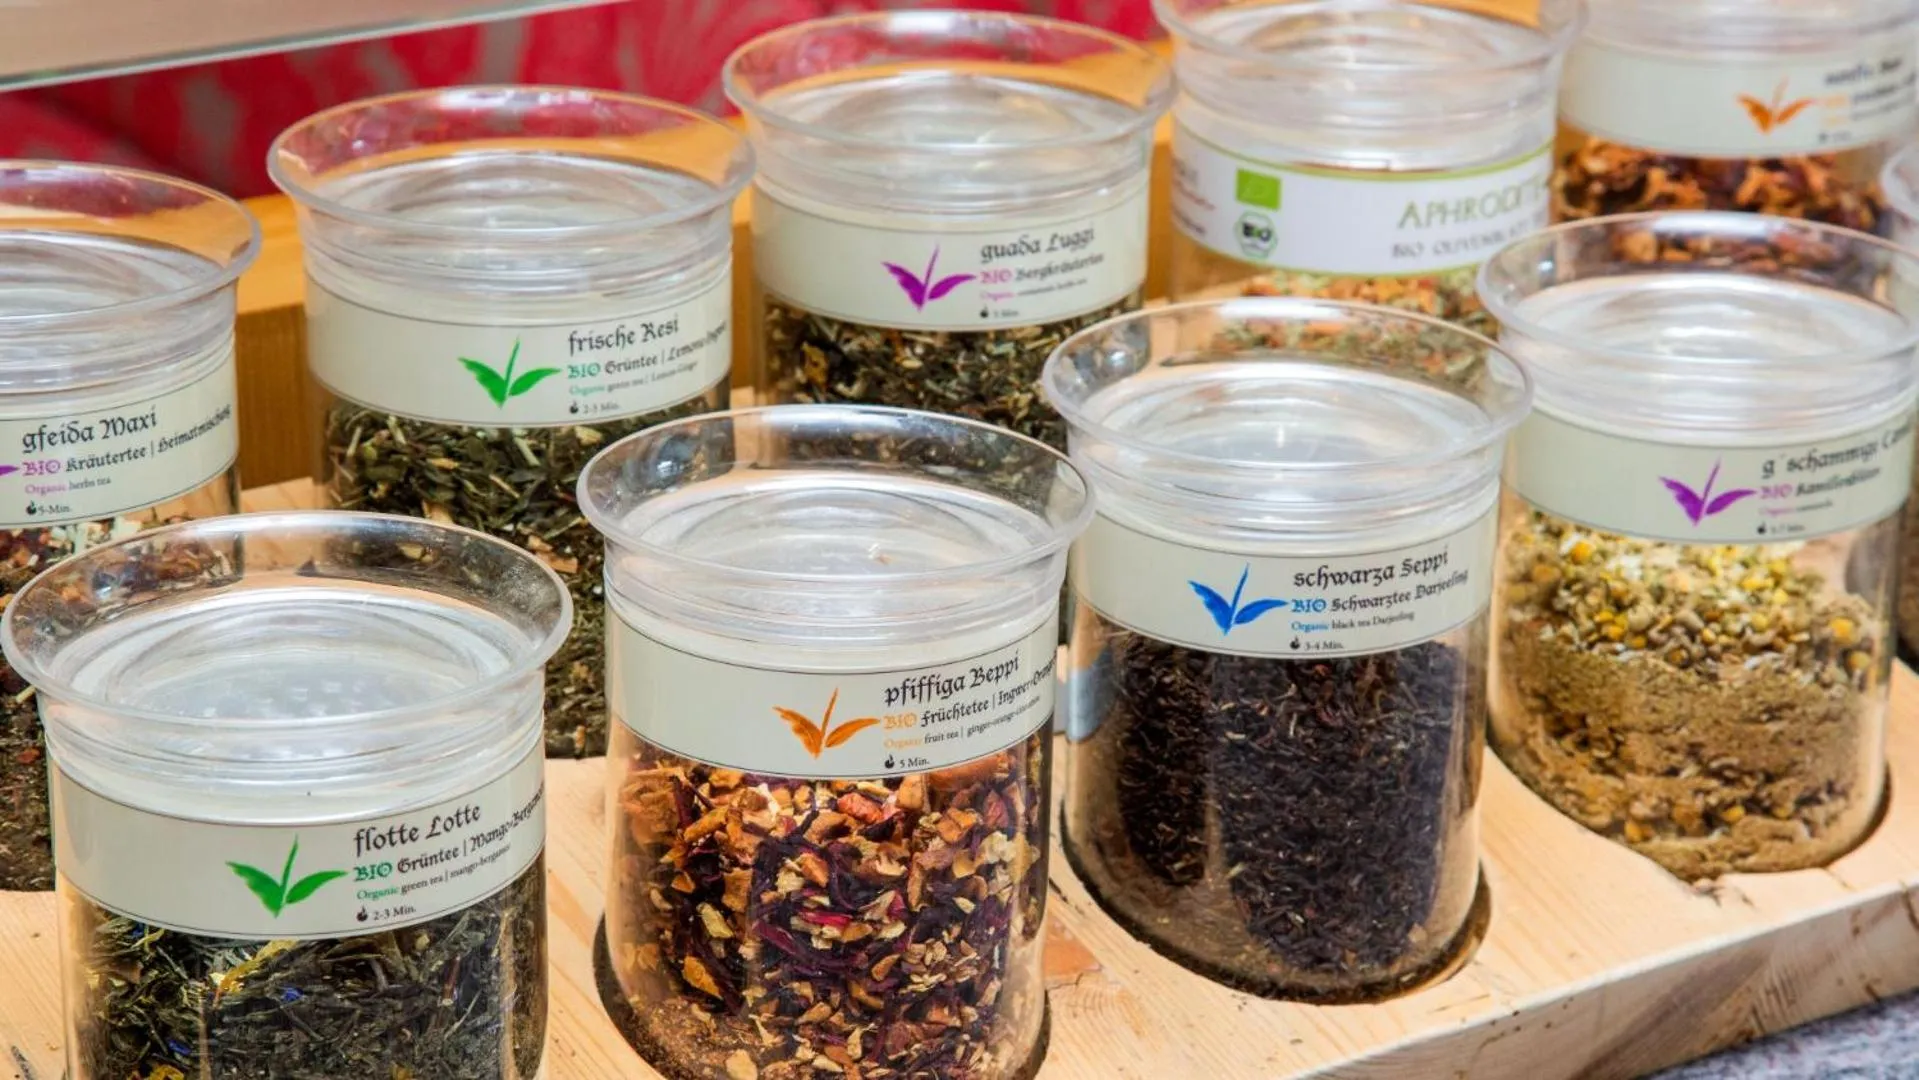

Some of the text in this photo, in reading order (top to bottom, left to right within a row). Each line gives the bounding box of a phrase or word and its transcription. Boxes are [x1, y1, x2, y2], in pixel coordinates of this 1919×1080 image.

[980, 222, 1095, 263] guada Luggi
[980, 268, 1012, 284] BIO
[568, 313, 679, 357] frische Resi
[567, 363, 600, 379] BIO
[605, 354, 657, 375] Grüntee
[22, 405, 157, 453] gfeida Maxi
[22, 459, 61, 477] BIO
[65, 446, 146, 472] Kräutertee
[25, 484, 67, 496] Organic
[1293, 544, 1449, 591] schwarza Seppi
[1291, 569, 1469, 614] BIO Schwarztee Darjeeling
[1291, 621, 1330, 635] Organic
[1331, 619, 1354, 630] black
[1357, 618, 1371, 628] tea
[1322, 640, 1344, 651] Min.
[884, 648, 1020, 707] pfiffiga Beppi
[882, 712, 917, 731] BIO
[920, 699, 989, 728] Früchtetee
[924, 730, 944, 745] fruit
[947, 730, 959, 741] tea
[907, 756, 930, 768] Min.
[353, 804, 481, 858] flotte Lotte
[353, 861, 393, 882] BIO
[397, 846, 459, 875] Grüntee
[356, 886, 400, 901] Organic
[401, 879, 428, 895] green
[430, 874, 444, 886] tea
[372, 904, 417, 921] 2-3 Min.
